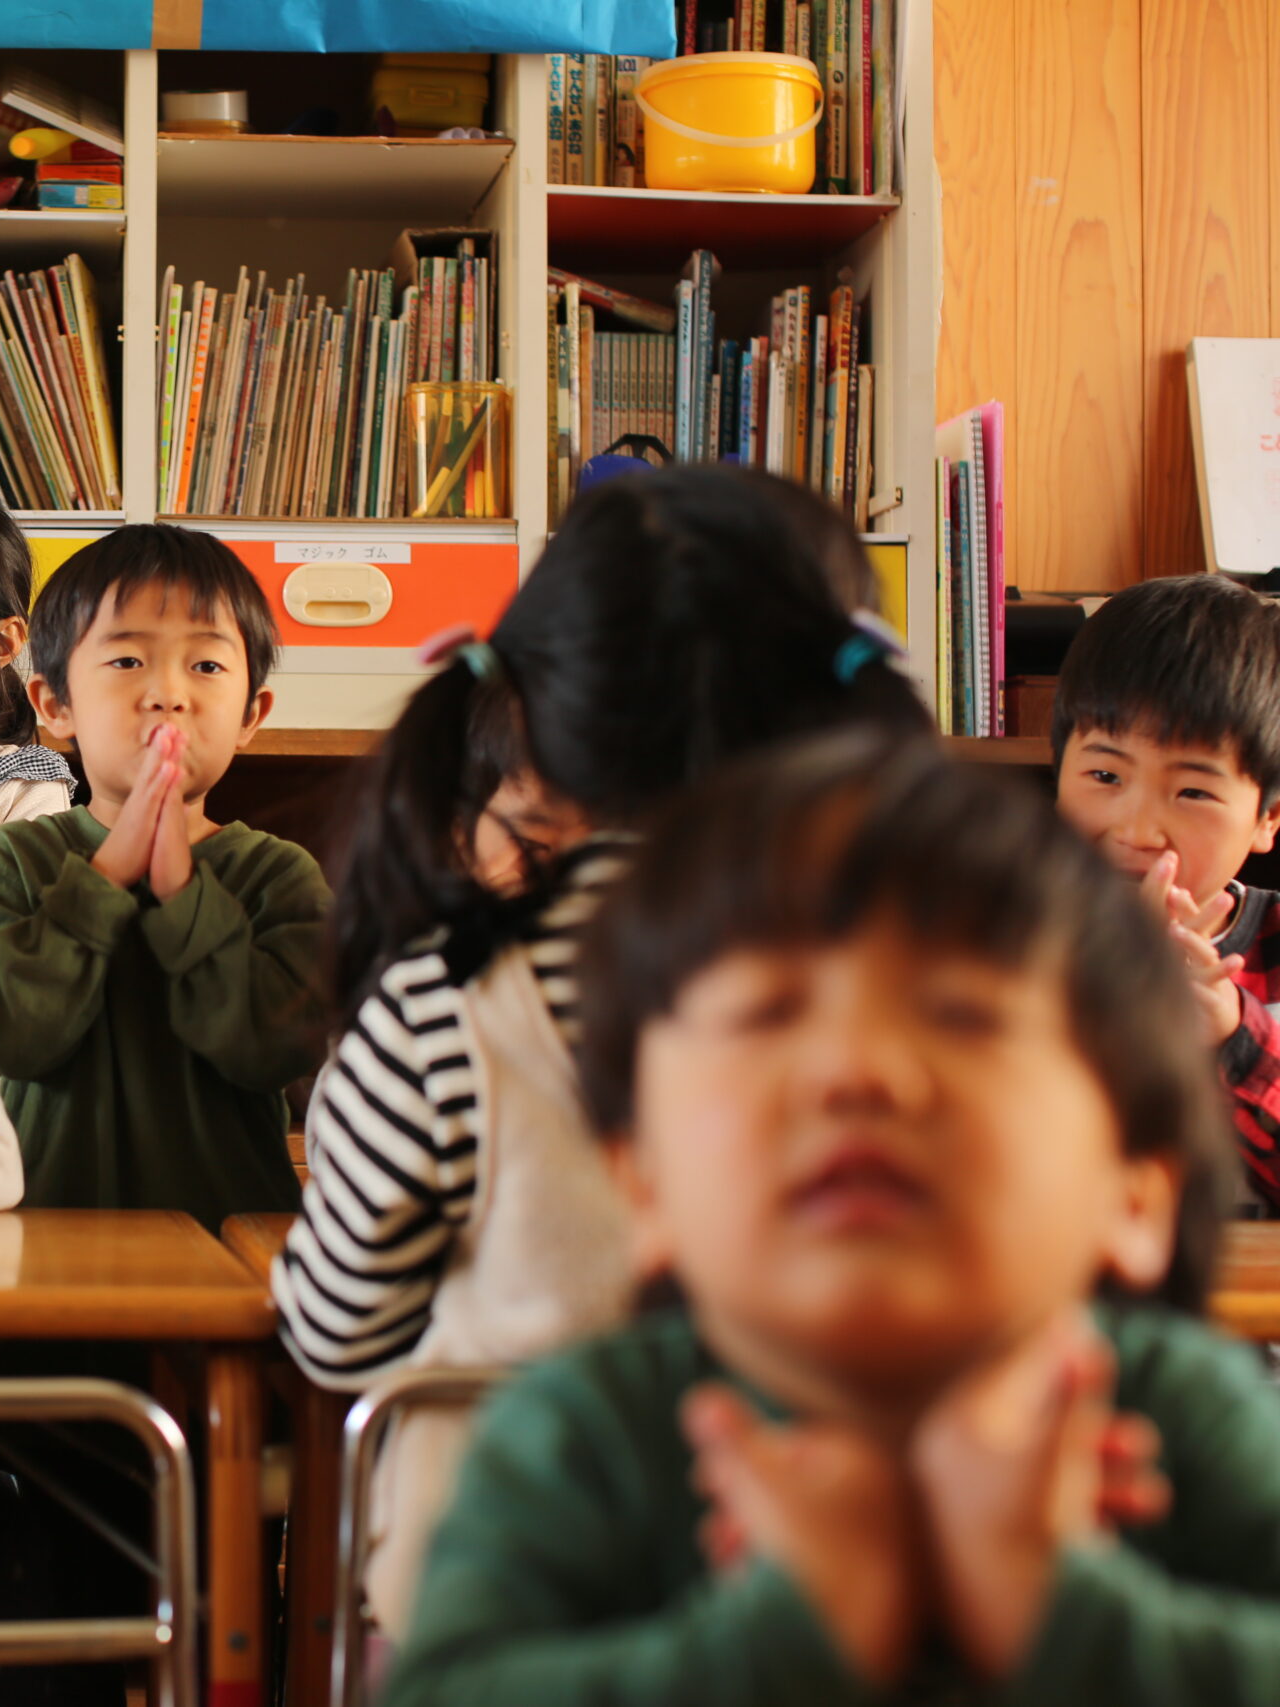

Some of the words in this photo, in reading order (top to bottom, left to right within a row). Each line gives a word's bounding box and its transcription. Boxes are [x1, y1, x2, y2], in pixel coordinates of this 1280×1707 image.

[298, 546, 347, 559] マジック
[364, 547, 388, 559] ゴム
